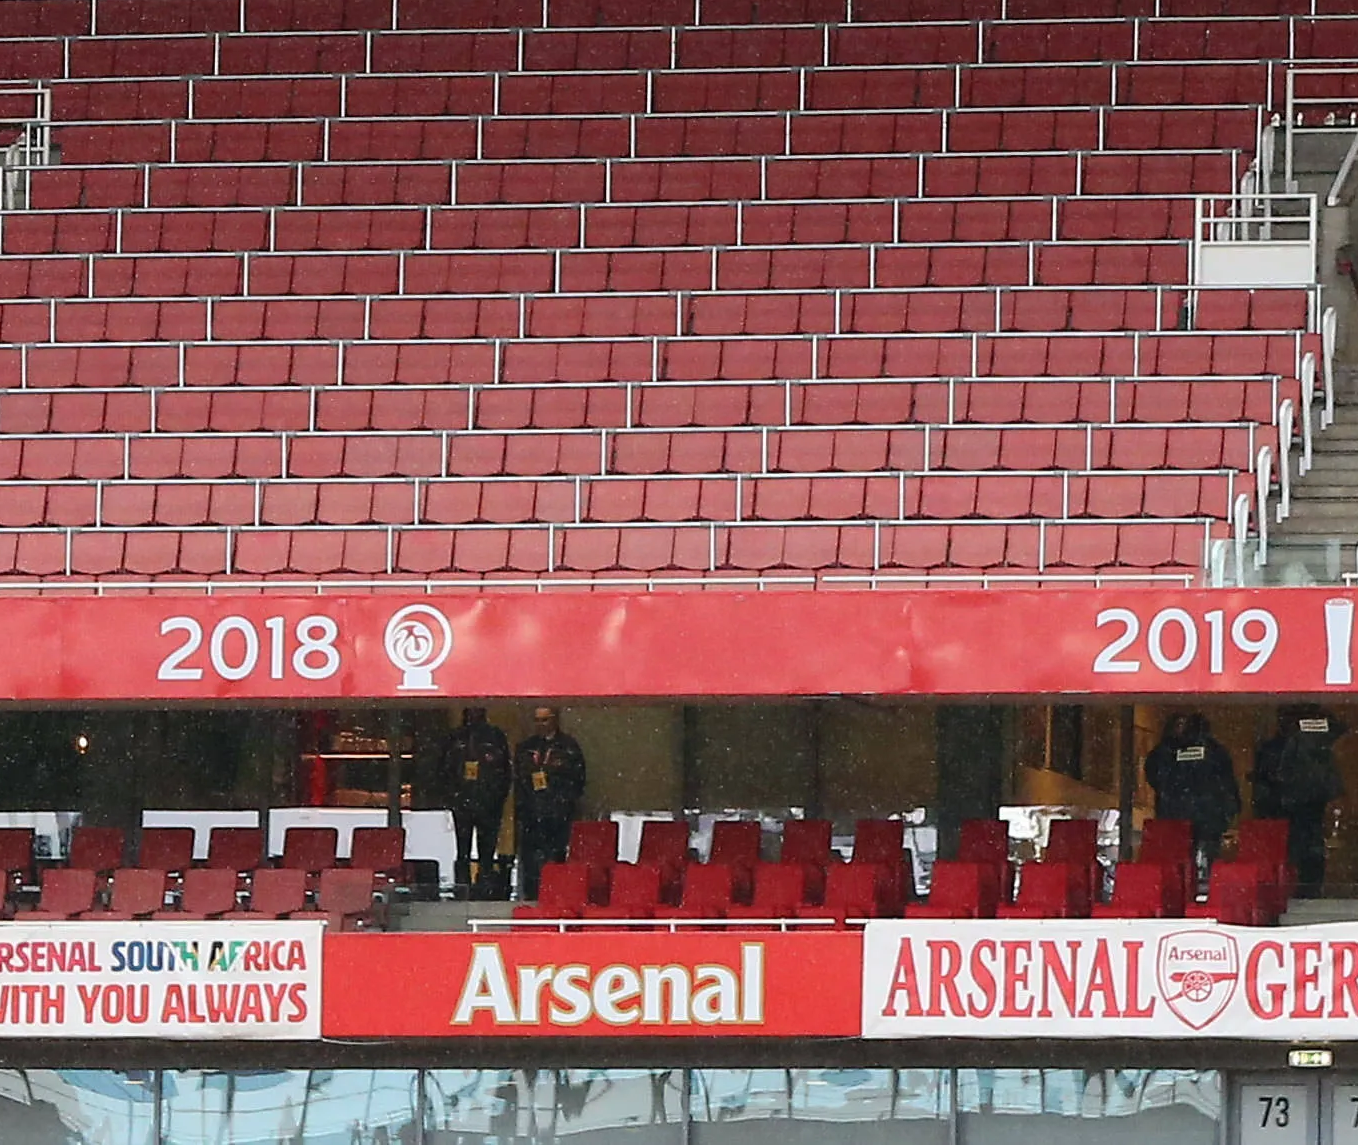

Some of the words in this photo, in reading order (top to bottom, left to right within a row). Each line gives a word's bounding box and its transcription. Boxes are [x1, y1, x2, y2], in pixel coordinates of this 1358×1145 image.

[156, 615, 341, 681] 2018
[1092, 607, 1279, 674] 2019
[110, 940, 199, 972] SOUTH
[209, 940, 307, 971] AFRICA
[882, 937, 1156, 1018] ARSENAL
[1168, 946, 1227, 962] Arsenal
[78, 985, 150, 1024] YOU
[161, 983, 308, 1024] ALWAYS
[450, 942, 765, 1026] Arsenal
[1259, 1097, 1290, 1128] 73
